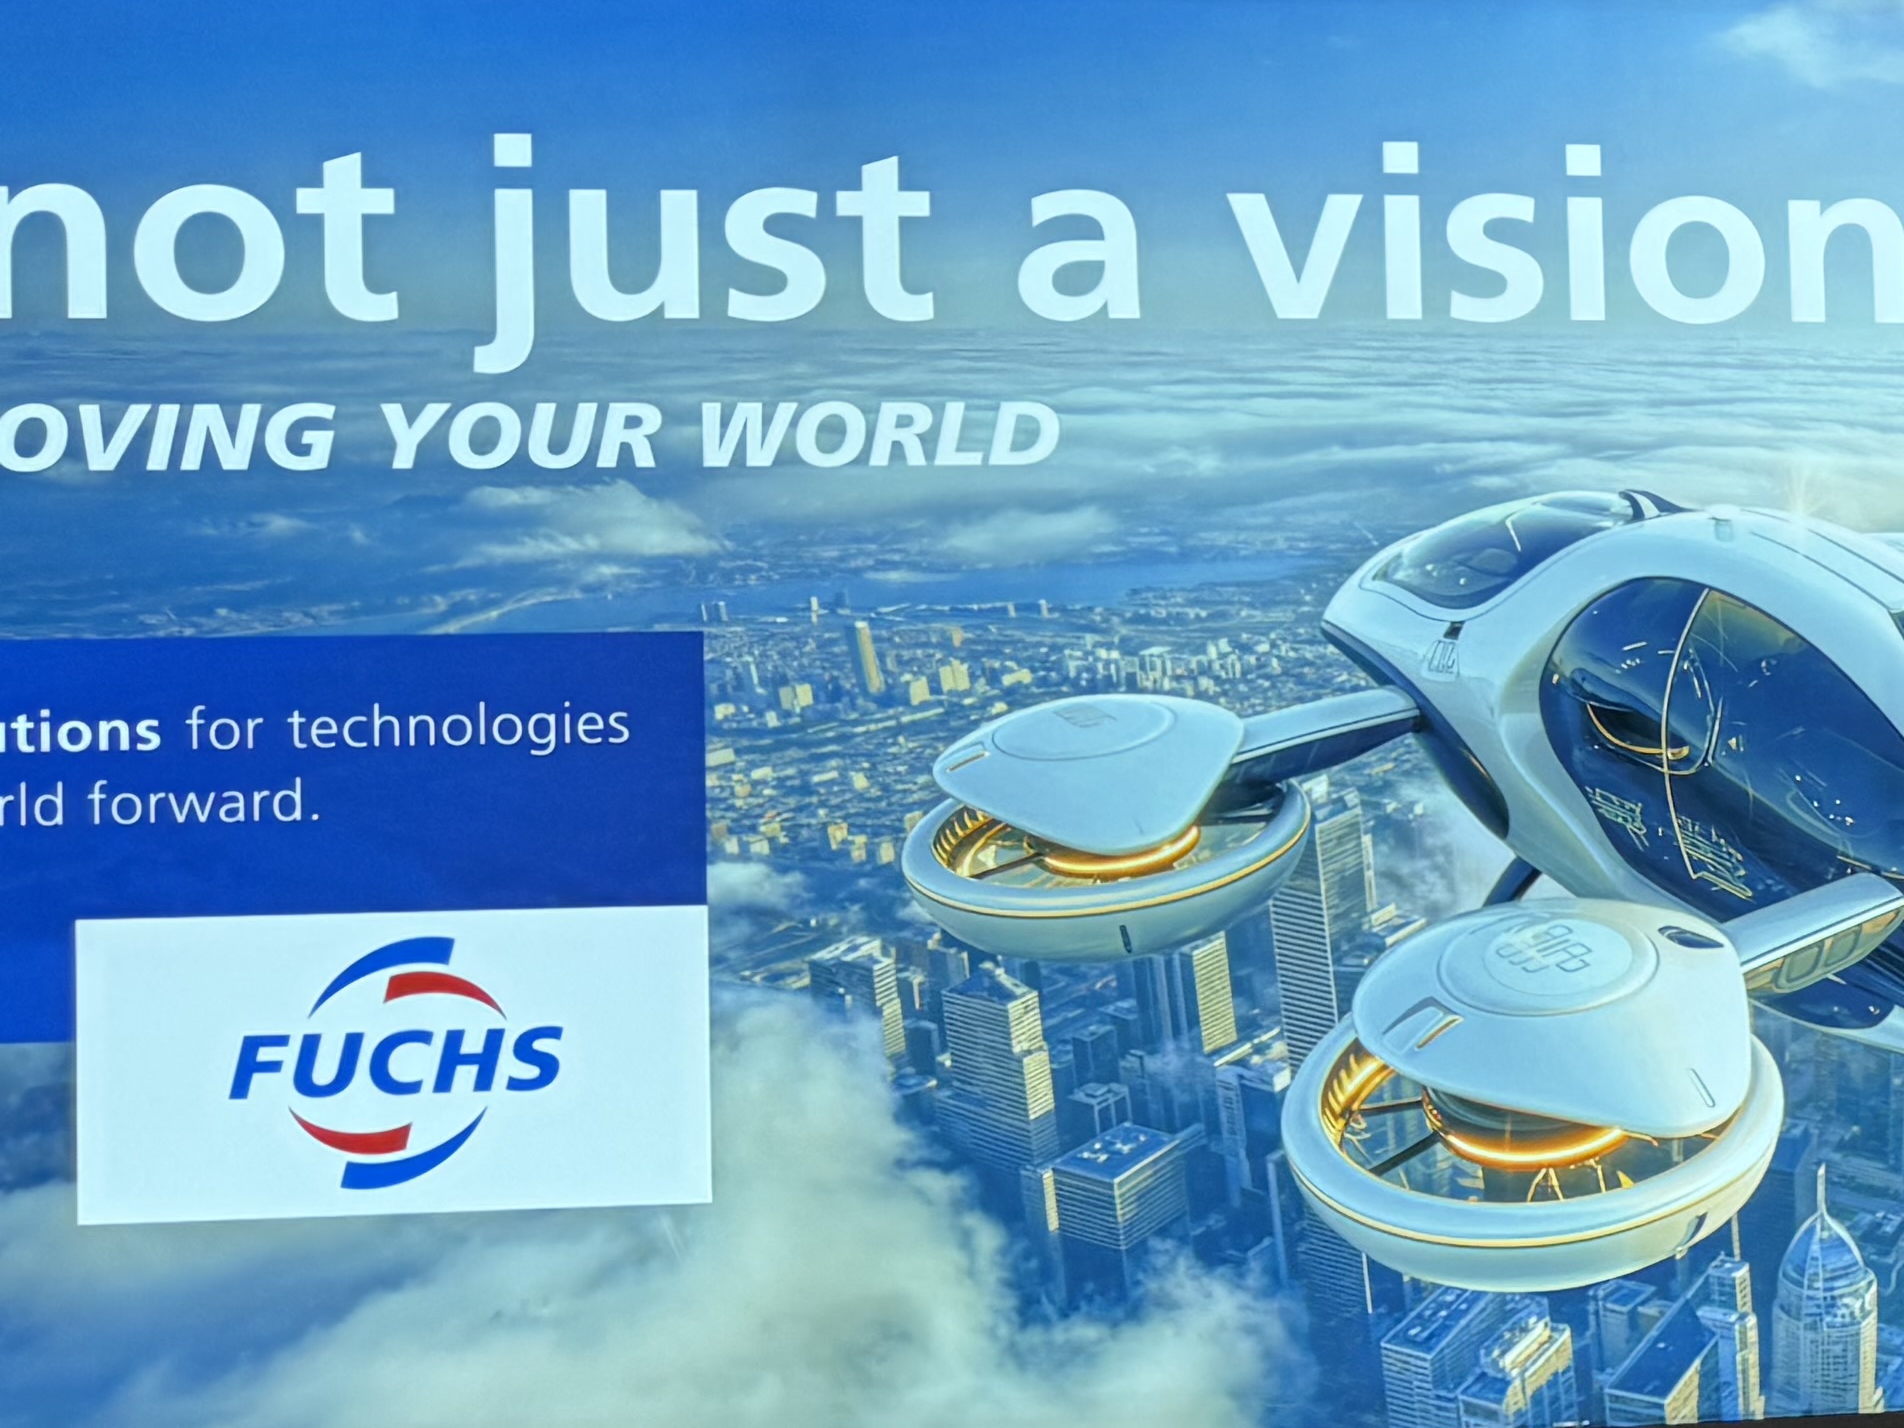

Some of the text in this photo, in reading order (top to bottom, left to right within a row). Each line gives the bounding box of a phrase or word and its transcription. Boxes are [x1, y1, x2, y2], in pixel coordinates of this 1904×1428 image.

[0, 152, 399, 324] not
[473, 132, 934, 376] just
[1016, 188, 1142, 322] a
[385, 401, 664, 470] YOUR
[700, 400, 1062, 469] WORLD
[0, 699, 632, 756] tions for technologies
[87, 777, 321, 826] forward.
[228, 1026, 563, 1100] FUCHS
